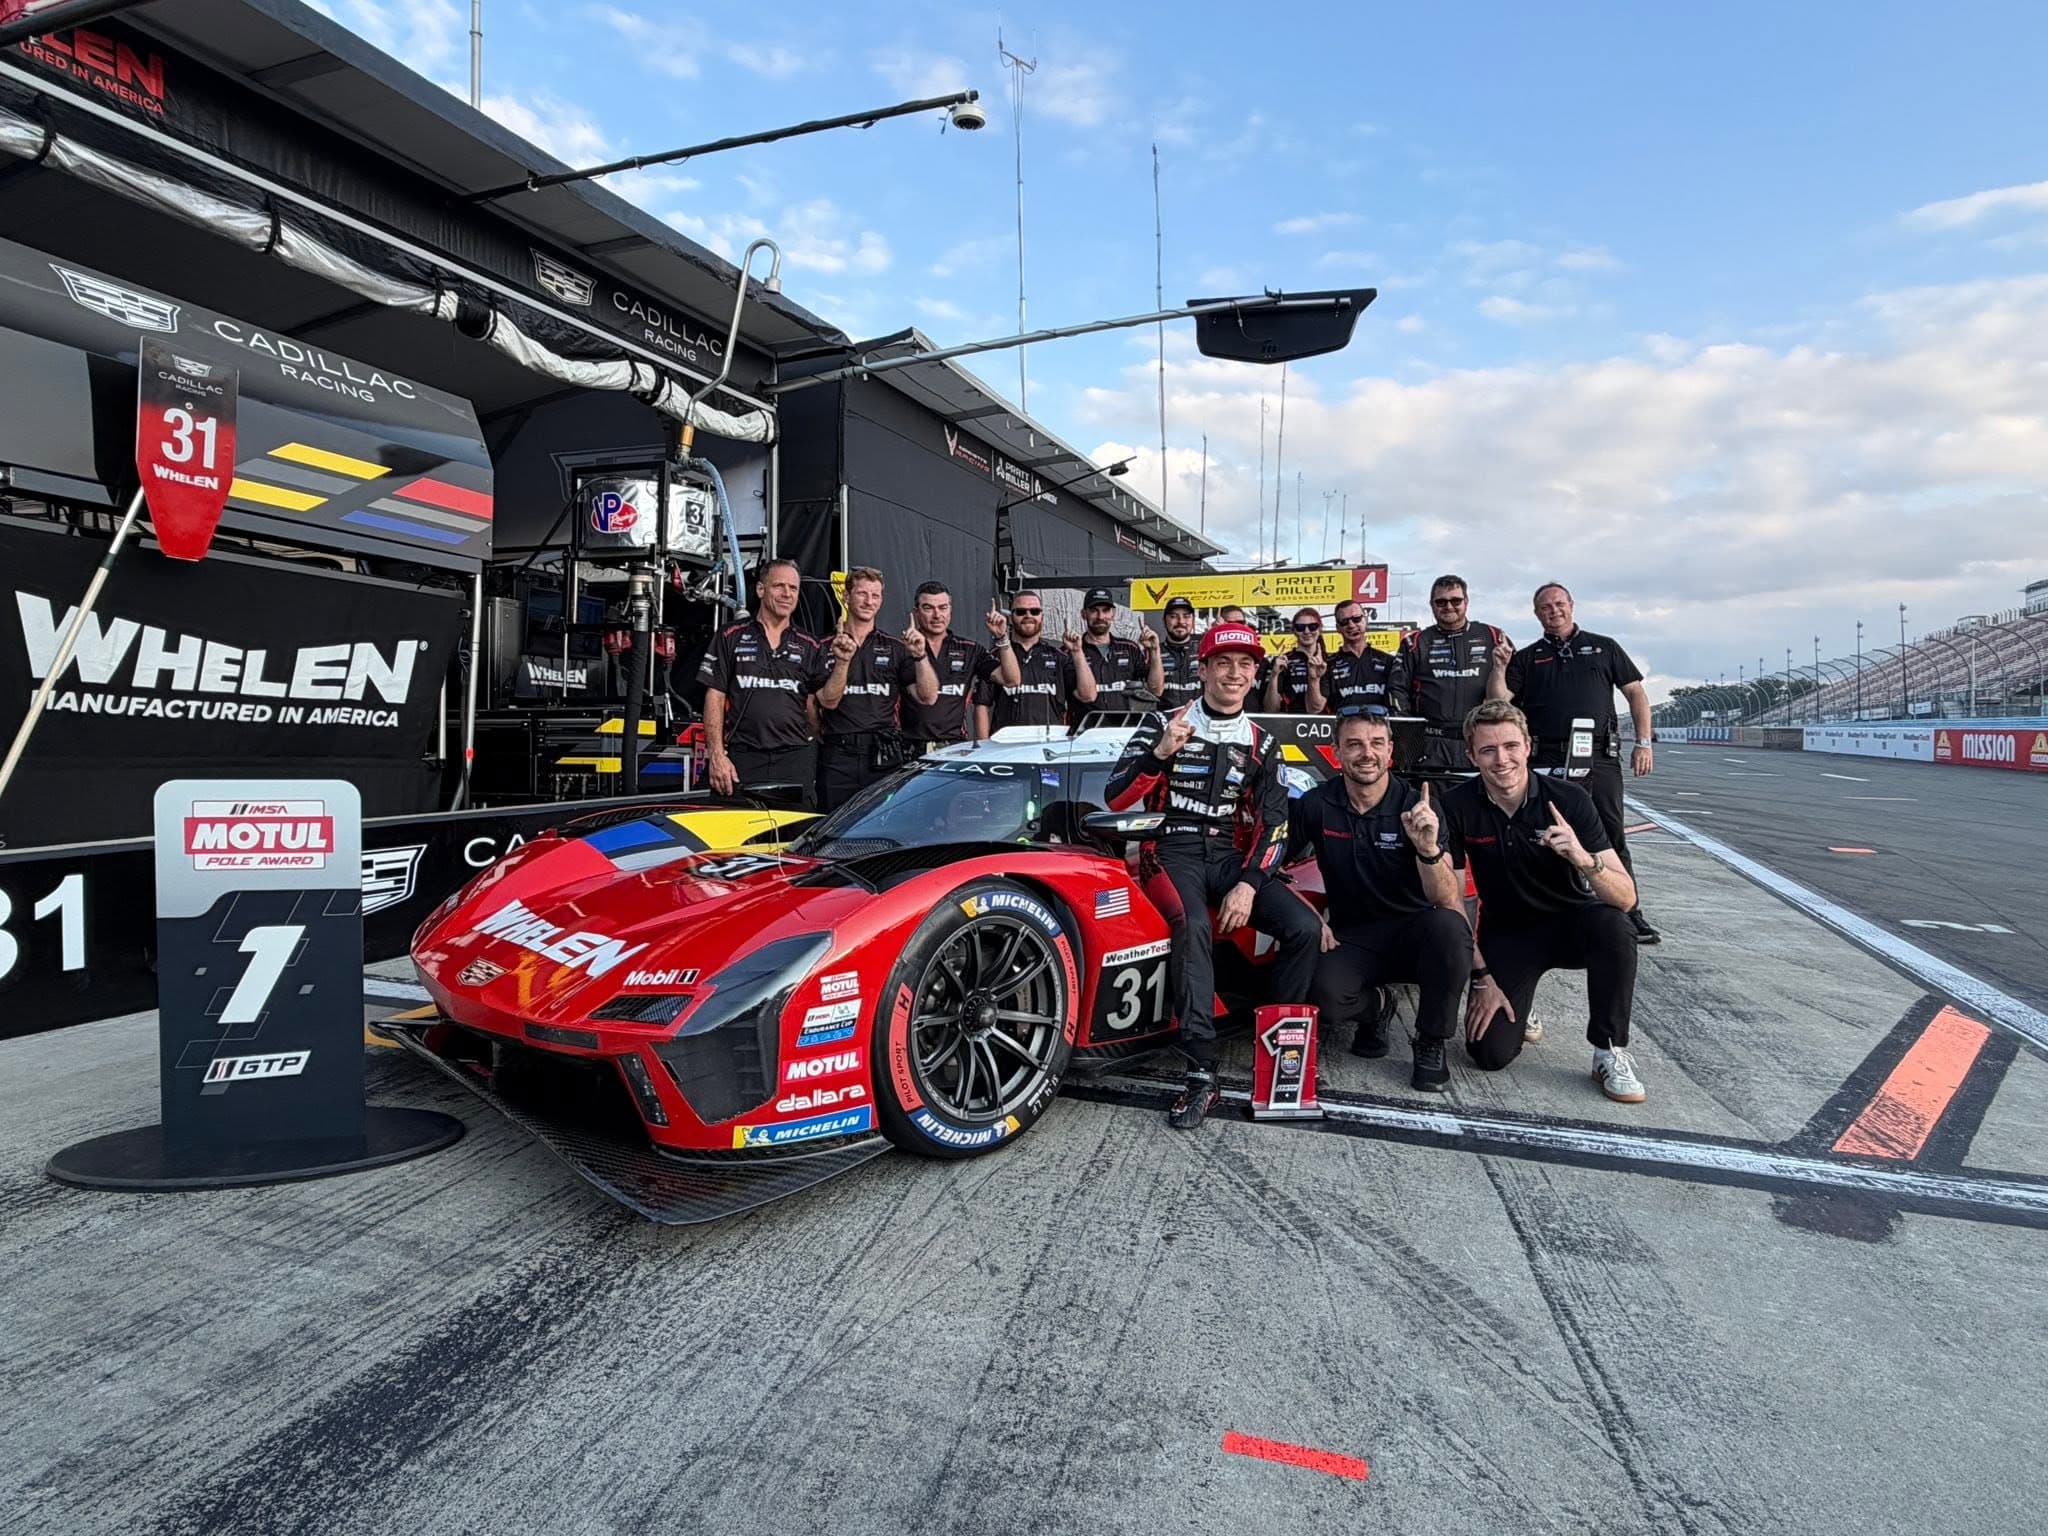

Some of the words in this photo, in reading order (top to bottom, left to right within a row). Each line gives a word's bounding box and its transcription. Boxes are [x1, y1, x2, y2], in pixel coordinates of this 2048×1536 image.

[72, 65, 89, 81] IN
[93, 77, 164, 116] AMERICA
[612, 291, 722, 357] CADILLAC
[644, 328, 697, 361] RACING
[213, 319, 417, 400] CADILLAC
[158, 371, 224, 395] CADILLAC
[175, 384, 207, 397] RACING
[279, 363, 376, 403] RACING
[161, 407, 217, 470] 31
[152, 463, 219, 490] WHELEN
[1005, 472, 1030, 492] MILLER
[1275, 585, 1335, 596] MILLER
[1276, 575, 1336, 586] PRATT
[1358, 571, 1379, 598] 4
[1219, 632, 1252, 645] MOTUL
[527, 662, 587, 684] WHELEN
[1431, 667, 1481, 679] WHELEN
[840, 683, 890, 697] HELEN
[277, 706, 302, 724] IN
[306, 707, 399, 728] AMERICA
[1296, 723, 1332, 738] CAD
[1962, 733, 2016, 762] MISSION
[248, 805, 288, 815] IMSA
[190, 822, 327, 850] MOTUL
[205, 856, 253, 866] POLE
[257, 856, 314, 866] AWARD
[991, 894, 1056, 931] MICHELIN
[471, 898, 650, 979] WHELEN
[217, 924, 307, 1024] 1
[624, 969, 678, 986] Mobil
[821, 978, 860, 995] MOTUL
[898, 993, 910, 1011] H
[1106, 961, 1167, 1030] 31
[237, 1056, 303, 1076] GTP
[786, 1051, 860, 1080] MOTUL
[894, 1042, 904, 1076] SPORT
[775, 1084, 866, 1113] dallara
[899, 1078, 913, 1103] PILOT
[774, 1115, 860, 1140] MICHELIN
[917, 1113, 992, 1145] MICHELIN
